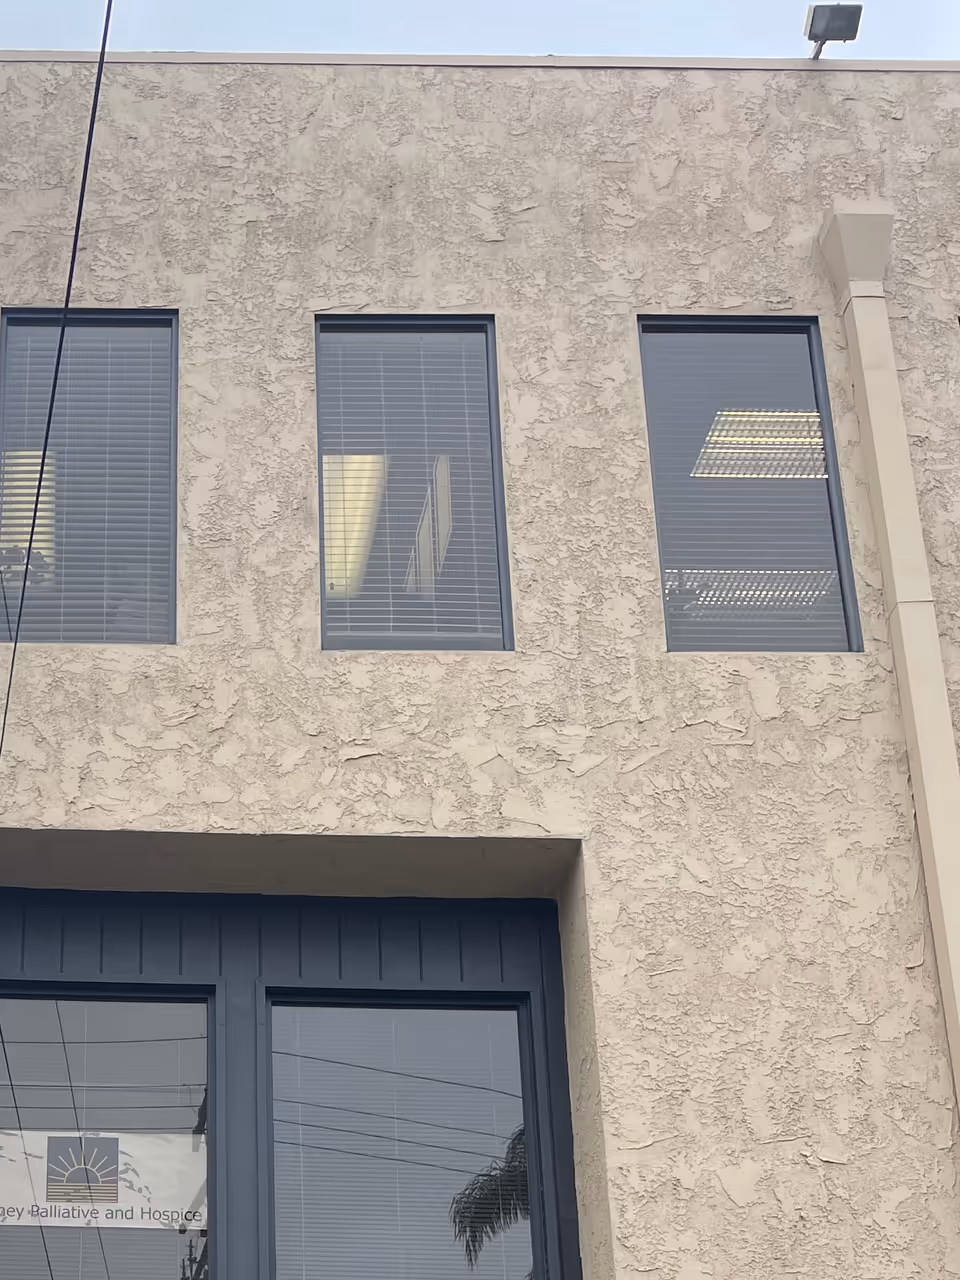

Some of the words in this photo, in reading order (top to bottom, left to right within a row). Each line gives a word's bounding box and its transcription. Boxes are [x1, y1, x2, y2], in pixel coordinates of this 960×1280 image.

[30, 1204, 100, 1219] Palliative
[105, 1205, 134, 1220] and
[140, 1207, 202, 1223] Hospice
